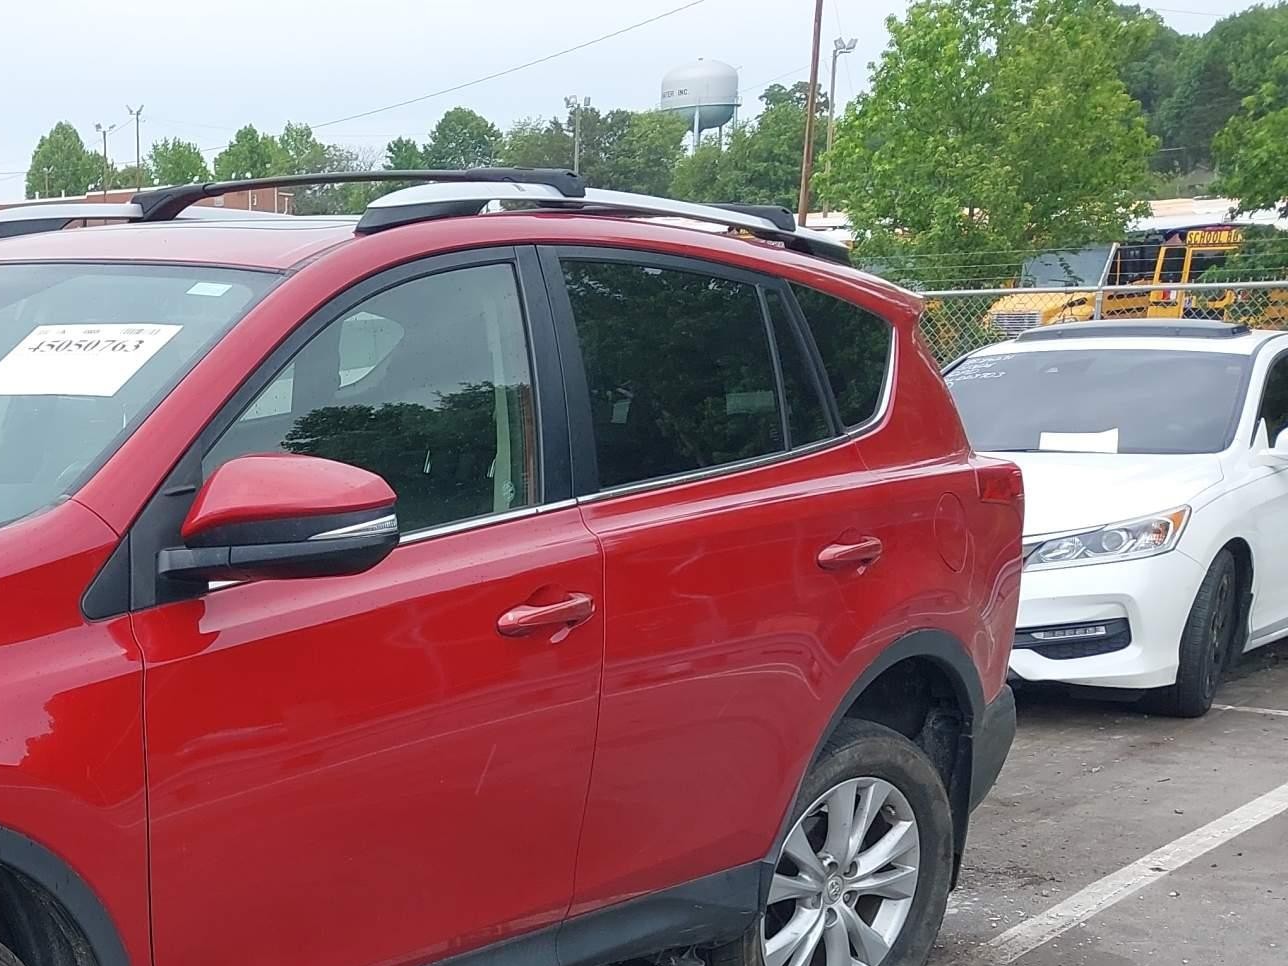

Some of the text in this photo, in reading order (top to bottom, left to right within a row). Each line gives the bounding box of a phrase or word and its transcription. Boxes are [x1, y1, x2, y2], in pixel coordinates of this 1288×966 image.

[1188, 230, 1243, 243] SCHOOL BU
[27, 339, 145, 353] 45050763
